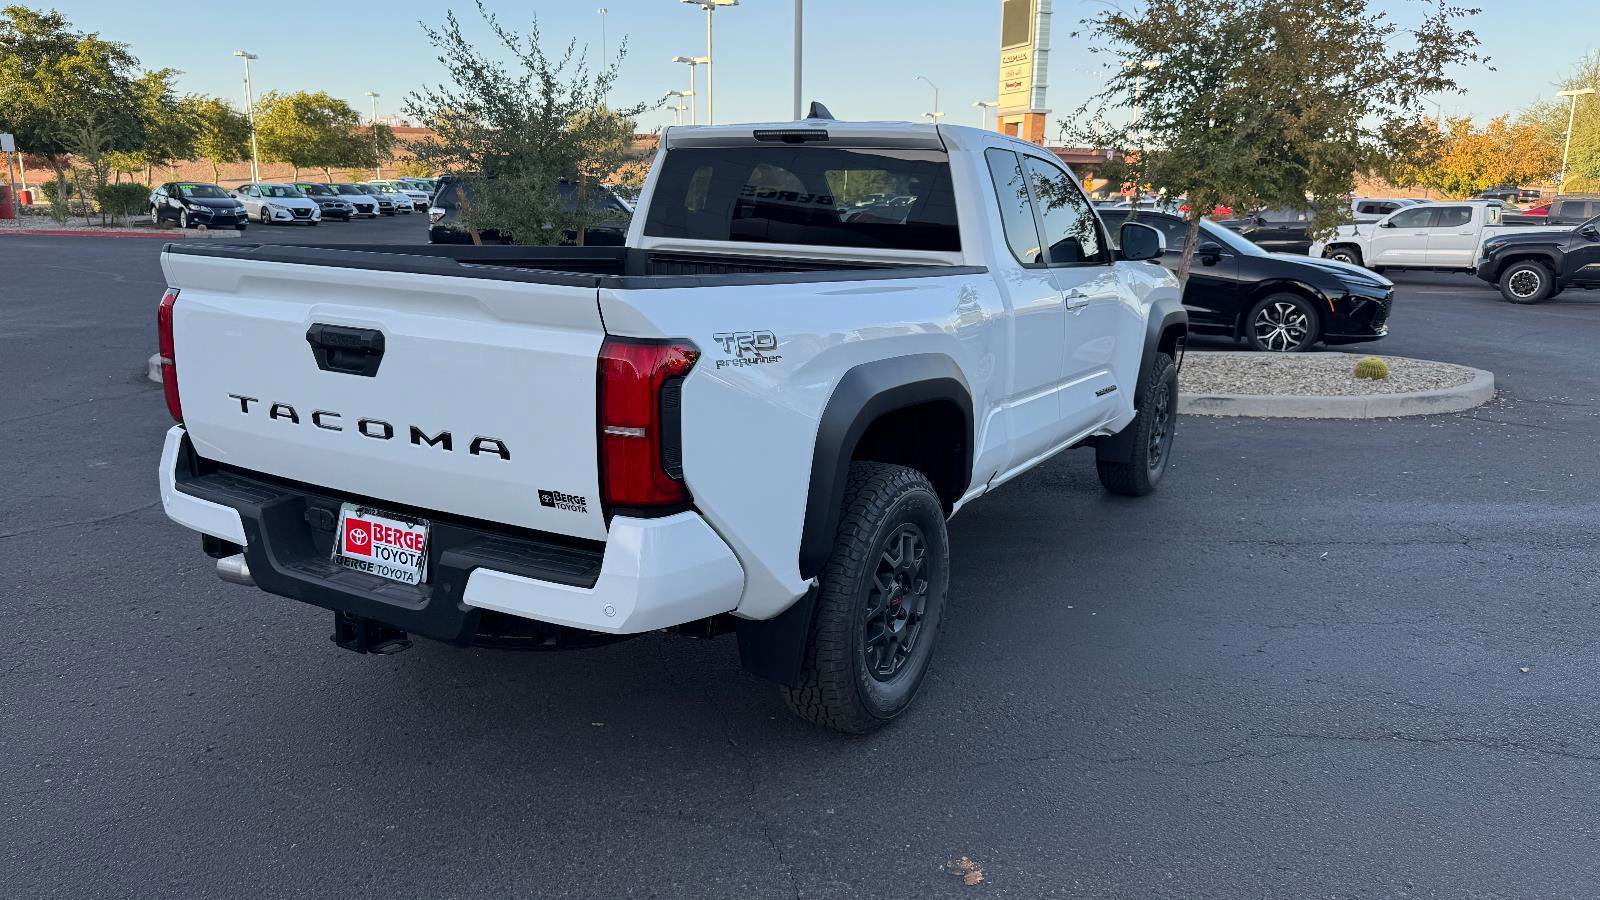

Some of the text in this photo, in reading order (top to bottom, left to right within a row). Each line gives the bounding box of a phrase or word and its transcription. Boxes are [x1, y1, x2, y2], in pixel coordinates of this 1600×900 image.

[713, 330, 777, 358] TRD
[228, 393, 511, 461] TACOMA
[553, 491, 587, 505] BERGE
[556, 502, 588, 514] TOYOTA
[373, 523, 423, 552] BERGE
[335, 556, 414, 583] BERGE TOYOTA
[374, 545, 422, 568] TOYOTA
